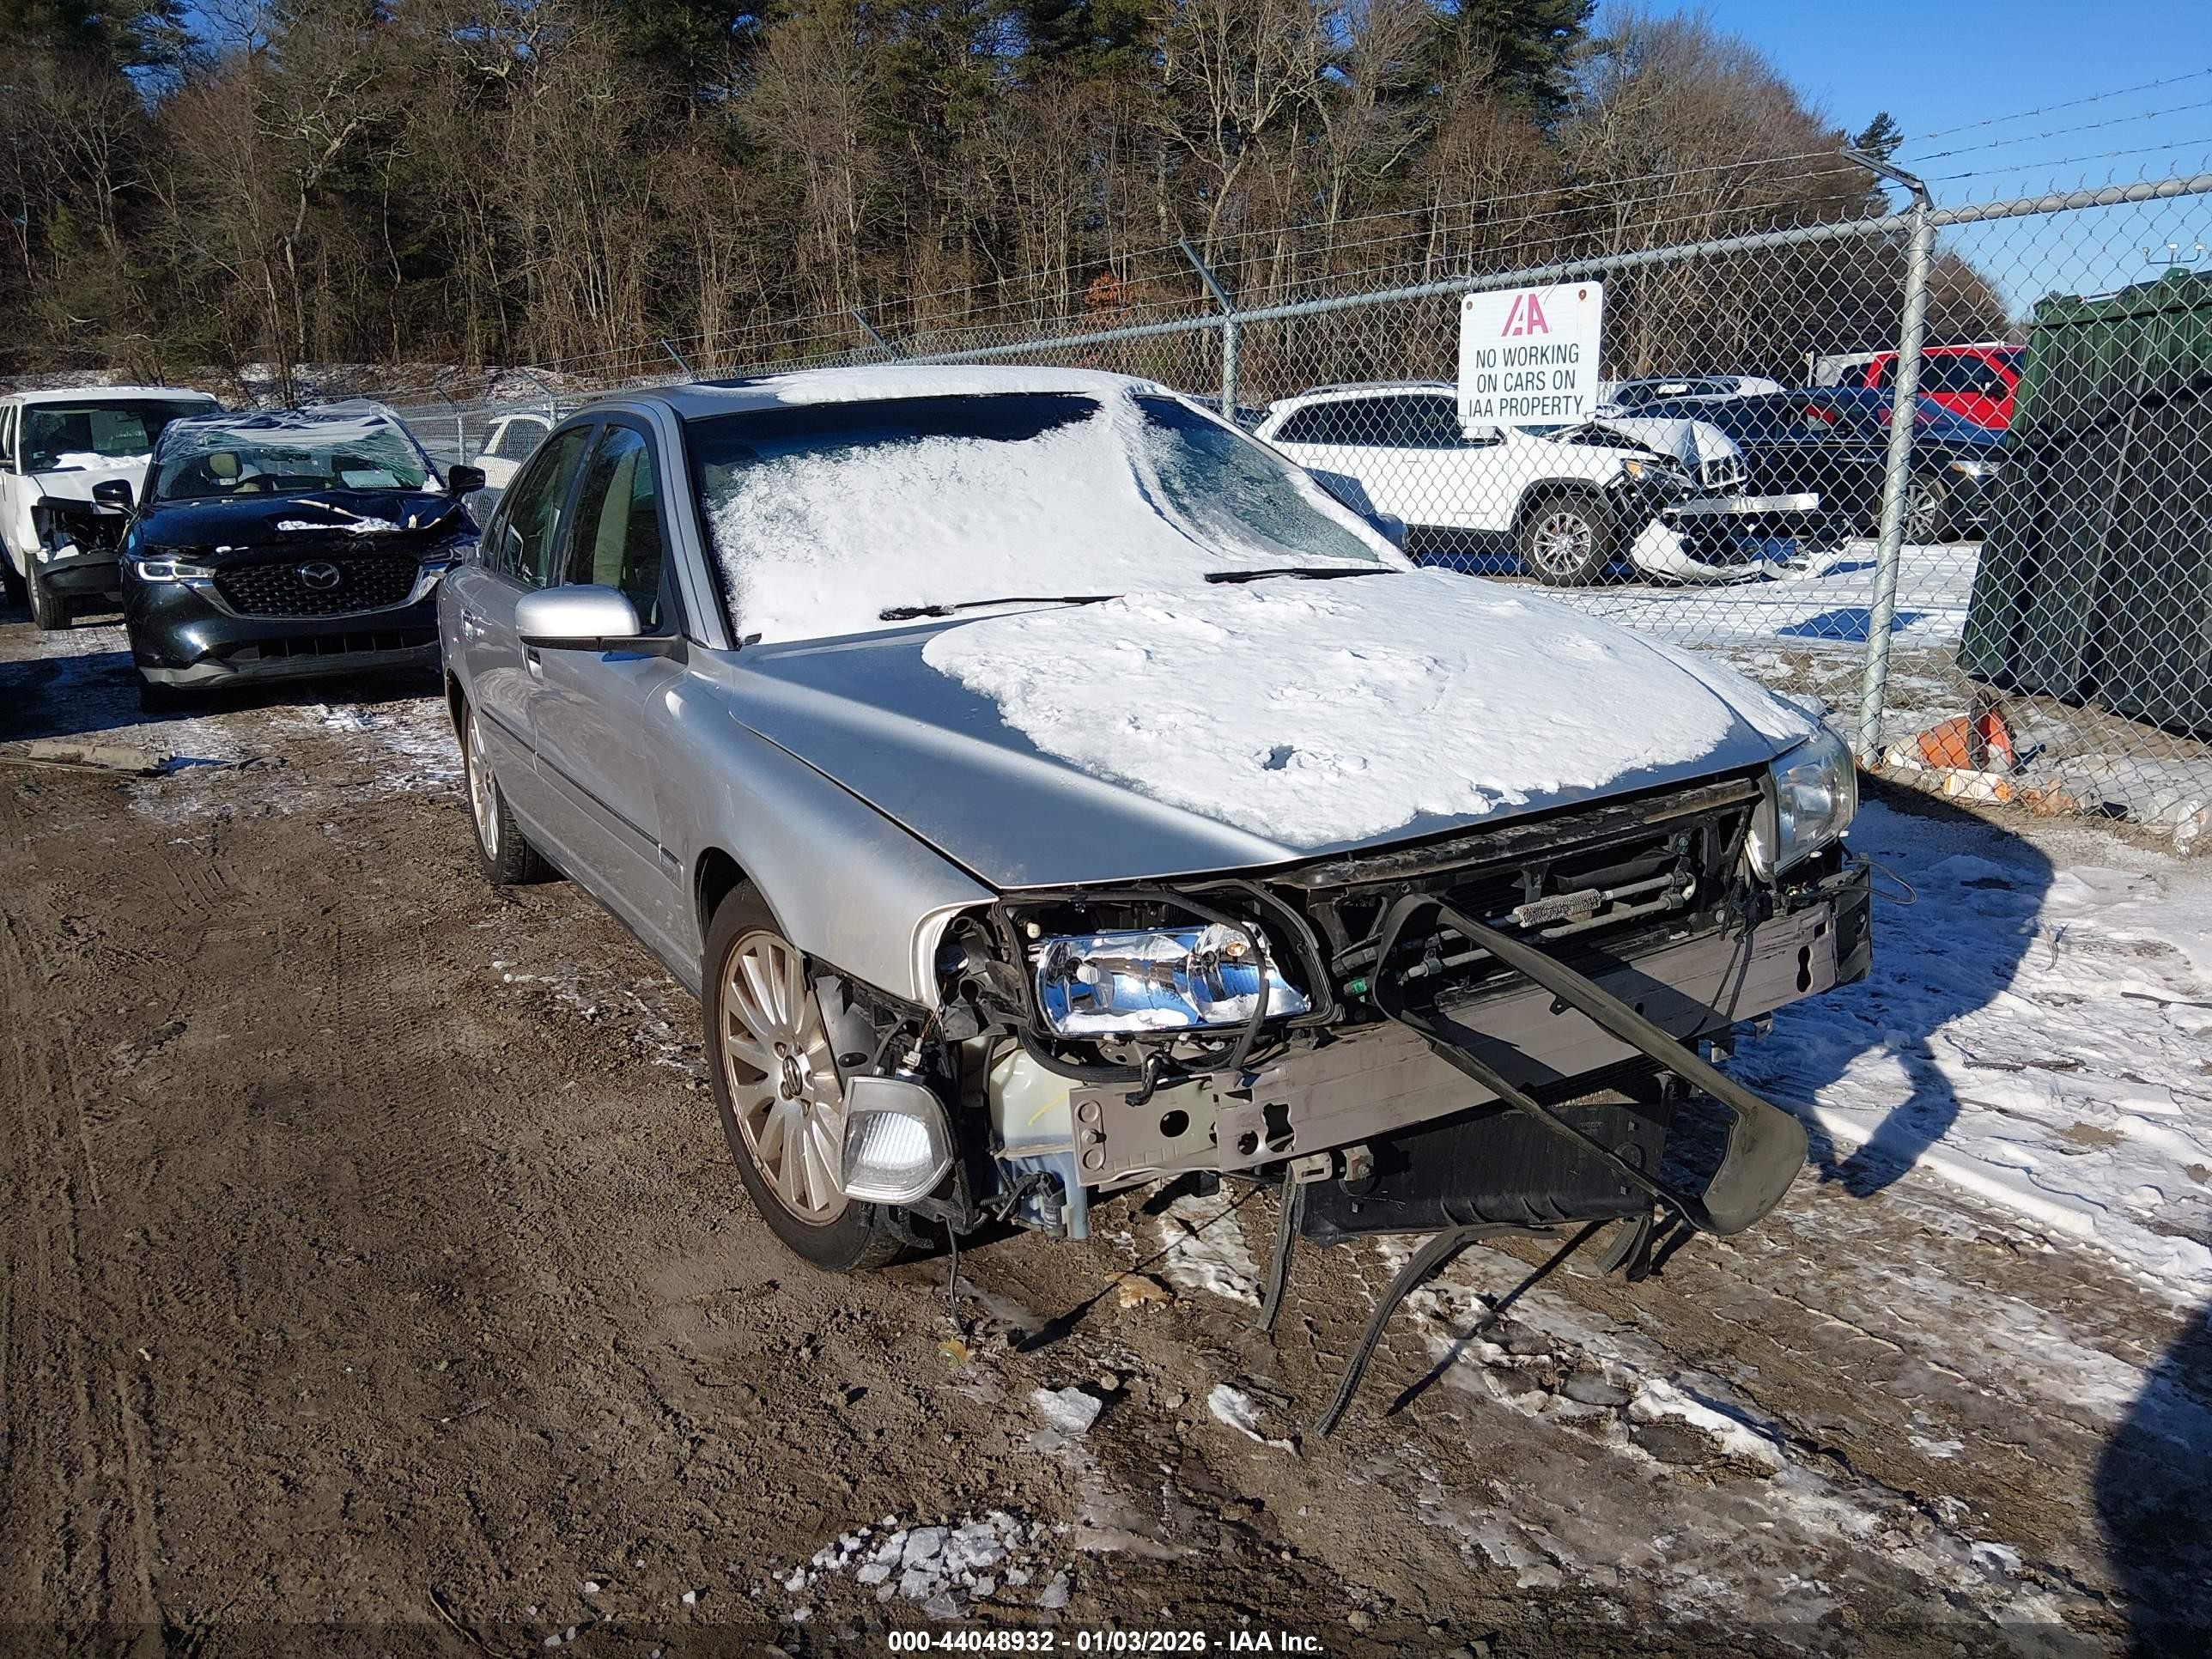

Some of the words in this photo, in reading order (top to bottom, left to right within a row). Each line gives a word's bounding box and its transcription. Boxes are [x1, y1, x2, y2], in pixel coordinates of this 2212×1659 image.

[1476, 349, 1497, 368] NO
[1503, 343, 1579, 368] WORKING
[1477, 374, 1497, 393] ON
[1504, 371, 1546, 392] CARS
[1553, 369, 1576, 390] ON
[1469, 398, 1493, 417] IAA
[1499, 395, 1583, 416] PROPERTY
